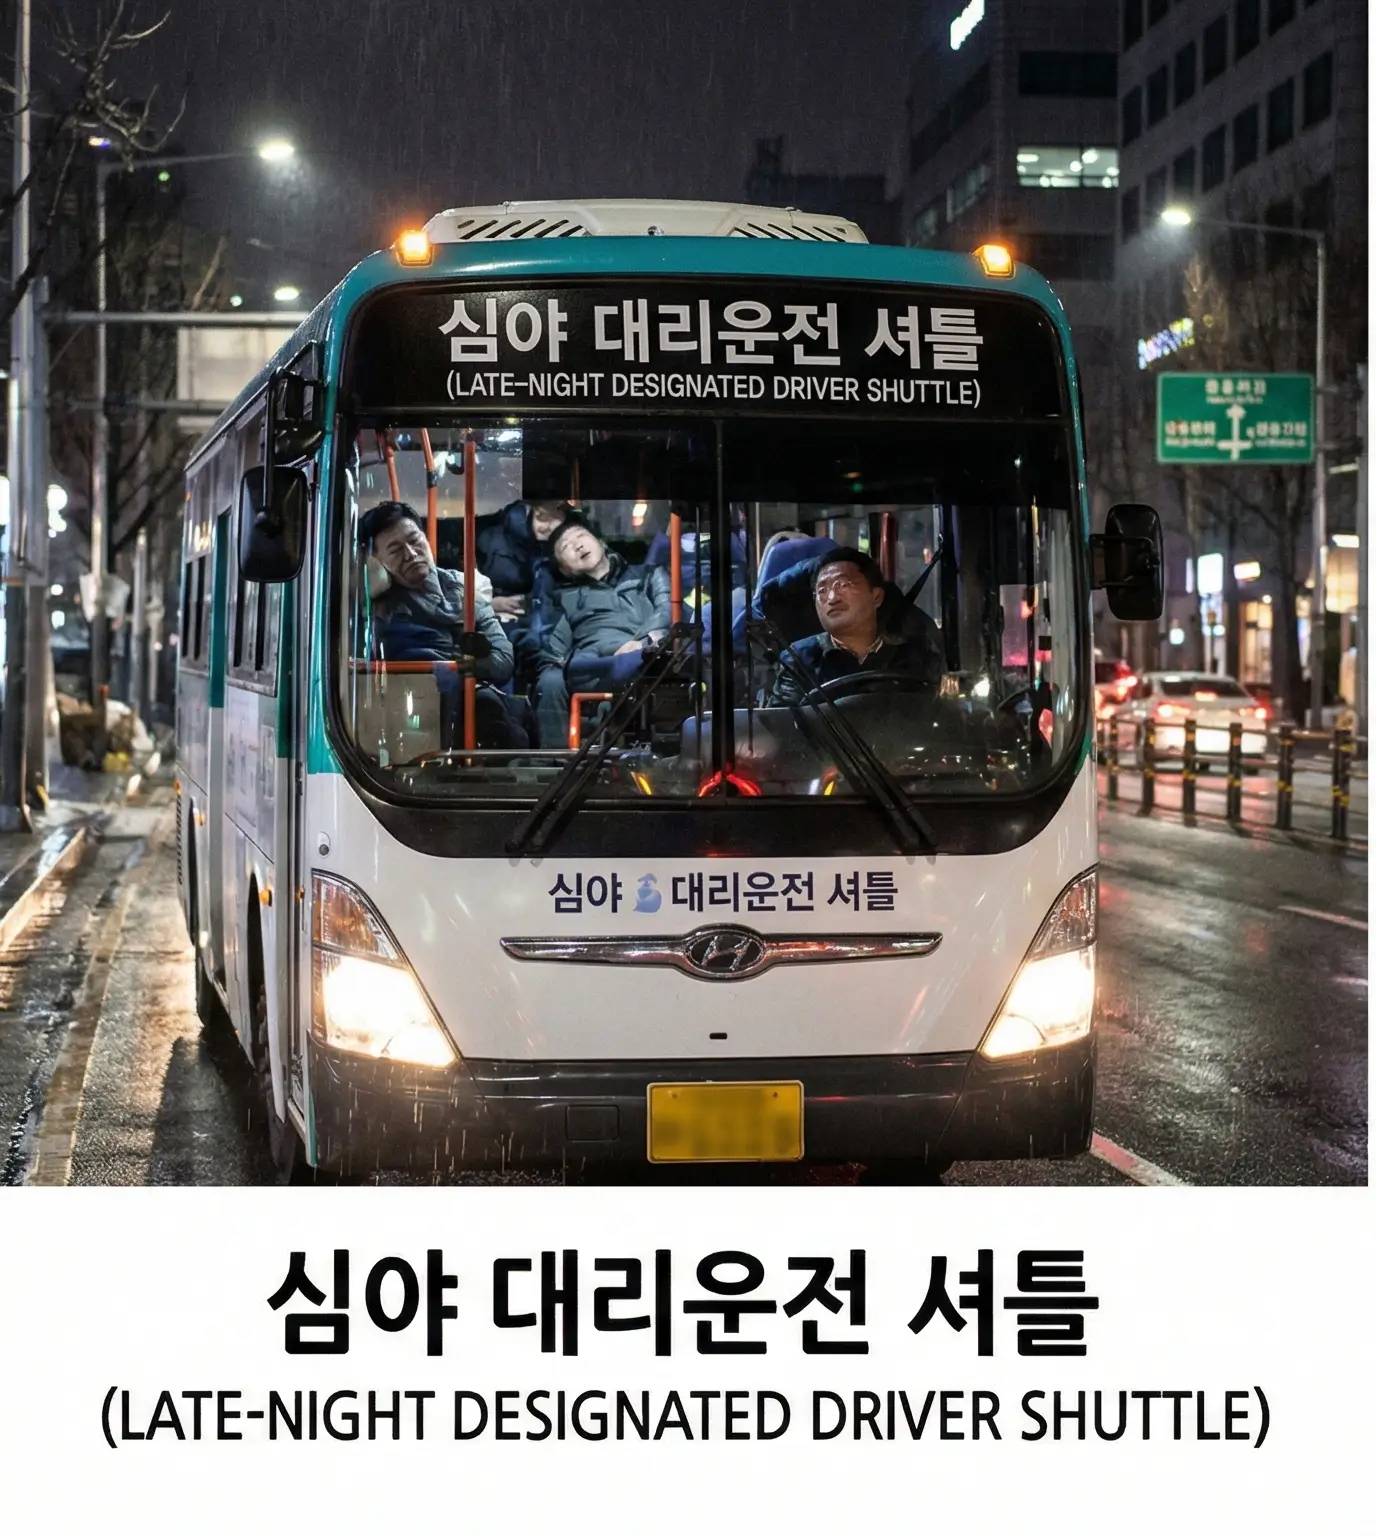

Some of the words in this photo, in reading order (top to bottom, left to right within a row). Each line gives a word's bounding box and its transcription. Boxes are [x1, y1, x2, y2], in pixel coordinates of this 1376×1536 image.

[438, 298, 568, 363] 심야
[593, 298, 841, 366] 대리운전
[865, 305, 984, 371] 셔틀
[446, 369, 605, 400] (LATE-NIGHT
[612, 373, 765, 398] DESIGNATED
[773, 376, 860, 401] DRIVER
[867, 378, 981, 408] SHUTTLE)
[548, 872, 623, 914] 심야
[671, 871, 815, 913] 대리운전
[827, 871, 899, 912] 셔틀
